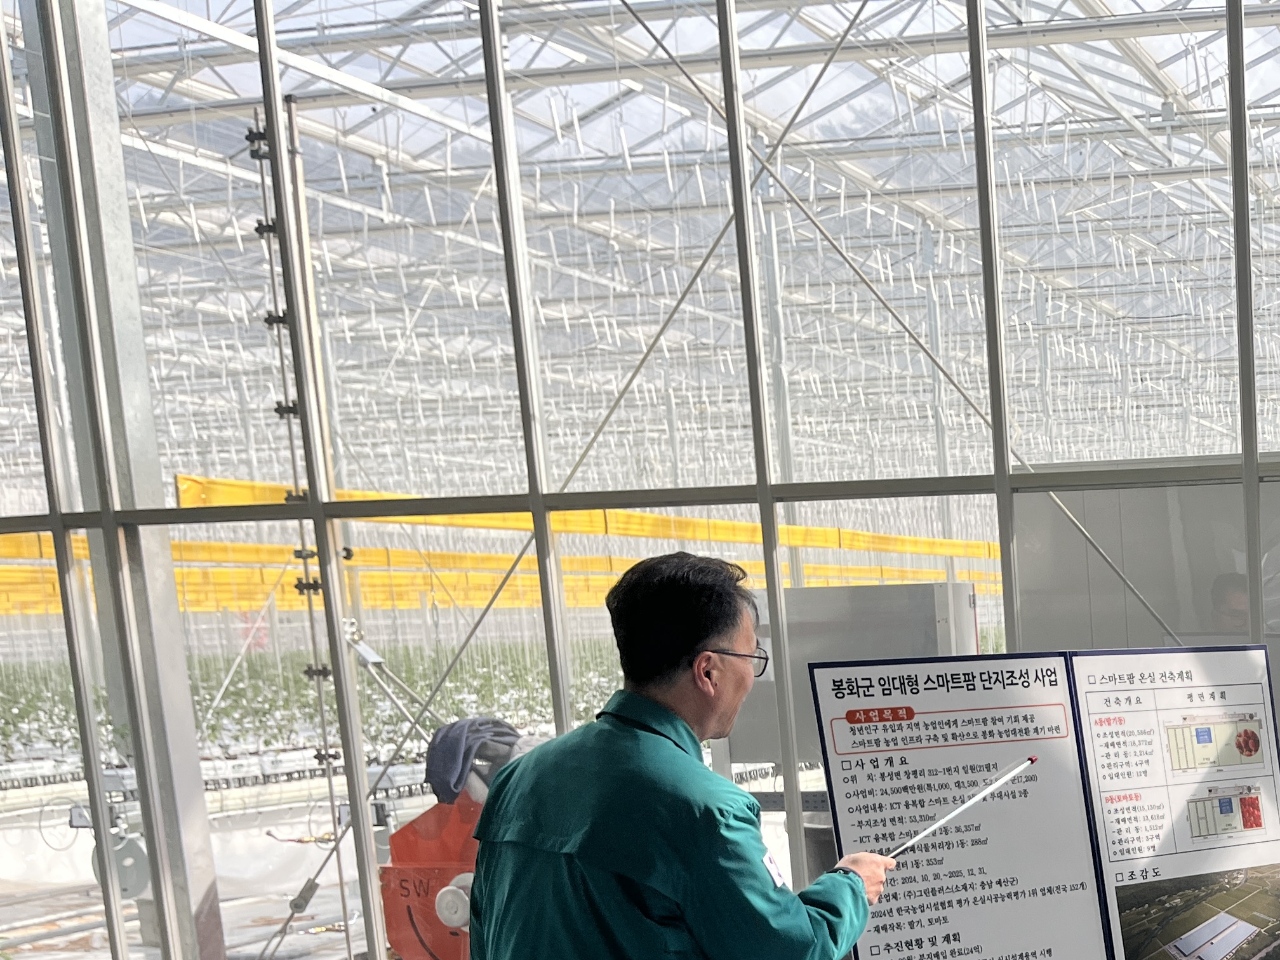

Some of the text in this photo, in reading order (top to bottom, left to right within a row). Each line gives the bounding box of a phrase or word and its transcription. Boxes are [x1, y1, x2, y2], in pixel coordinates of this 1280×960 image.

[831, 667, 1058, 699] 봉화군 임대형 스마트팜 단지조성 사업
[1099, 669, 1192, 685] 스마트팜 온실 건축계획
[849, 713, 1035, 736] 청년인구 유입과 지역 농업인에게 스마트팜 참여 기회 제공
[851, 737, 881, 748] 스마트팜
[883, 736, 898, 747] 농업
[900, 734, 923, 745] 인프라
[924, 733, 939, 743] 구축
[941, 732, 948, 742] 및
[980, 729, 995, 739] 봉화
[878, 770, 901, 781] 봉성면
[903, 768, 925, 779] 창평리
[850, 787, 877, 799] 사업비:
[852, 802, 887, 814] 사업내용:
[889, 801, 901, 810] ICT
[903, 798, 925, 809] 융복합
[927, 796, 949, 806] 스마트
[856, 816, 886, 829] 부지조성
[888, 815, 906, 826] 면적:
[858, 835, 871, 843] ICT
[873, 831, 895, 843] 융복합
[955, 838, 968, 848] 1동:
[910, 858, 924, 868] 1동:
[400, 879, 430, 898] SW
[979, 879, 993, 890] 충남
[870, 907, 894, 918] 2024년
[955, 896, 969, 908] 평가
[927, 915, 949, 926] 토마토
[883, 931, 960, 953] 추진현황 및 계획
[1039, 947, 1052, 957] 시행
